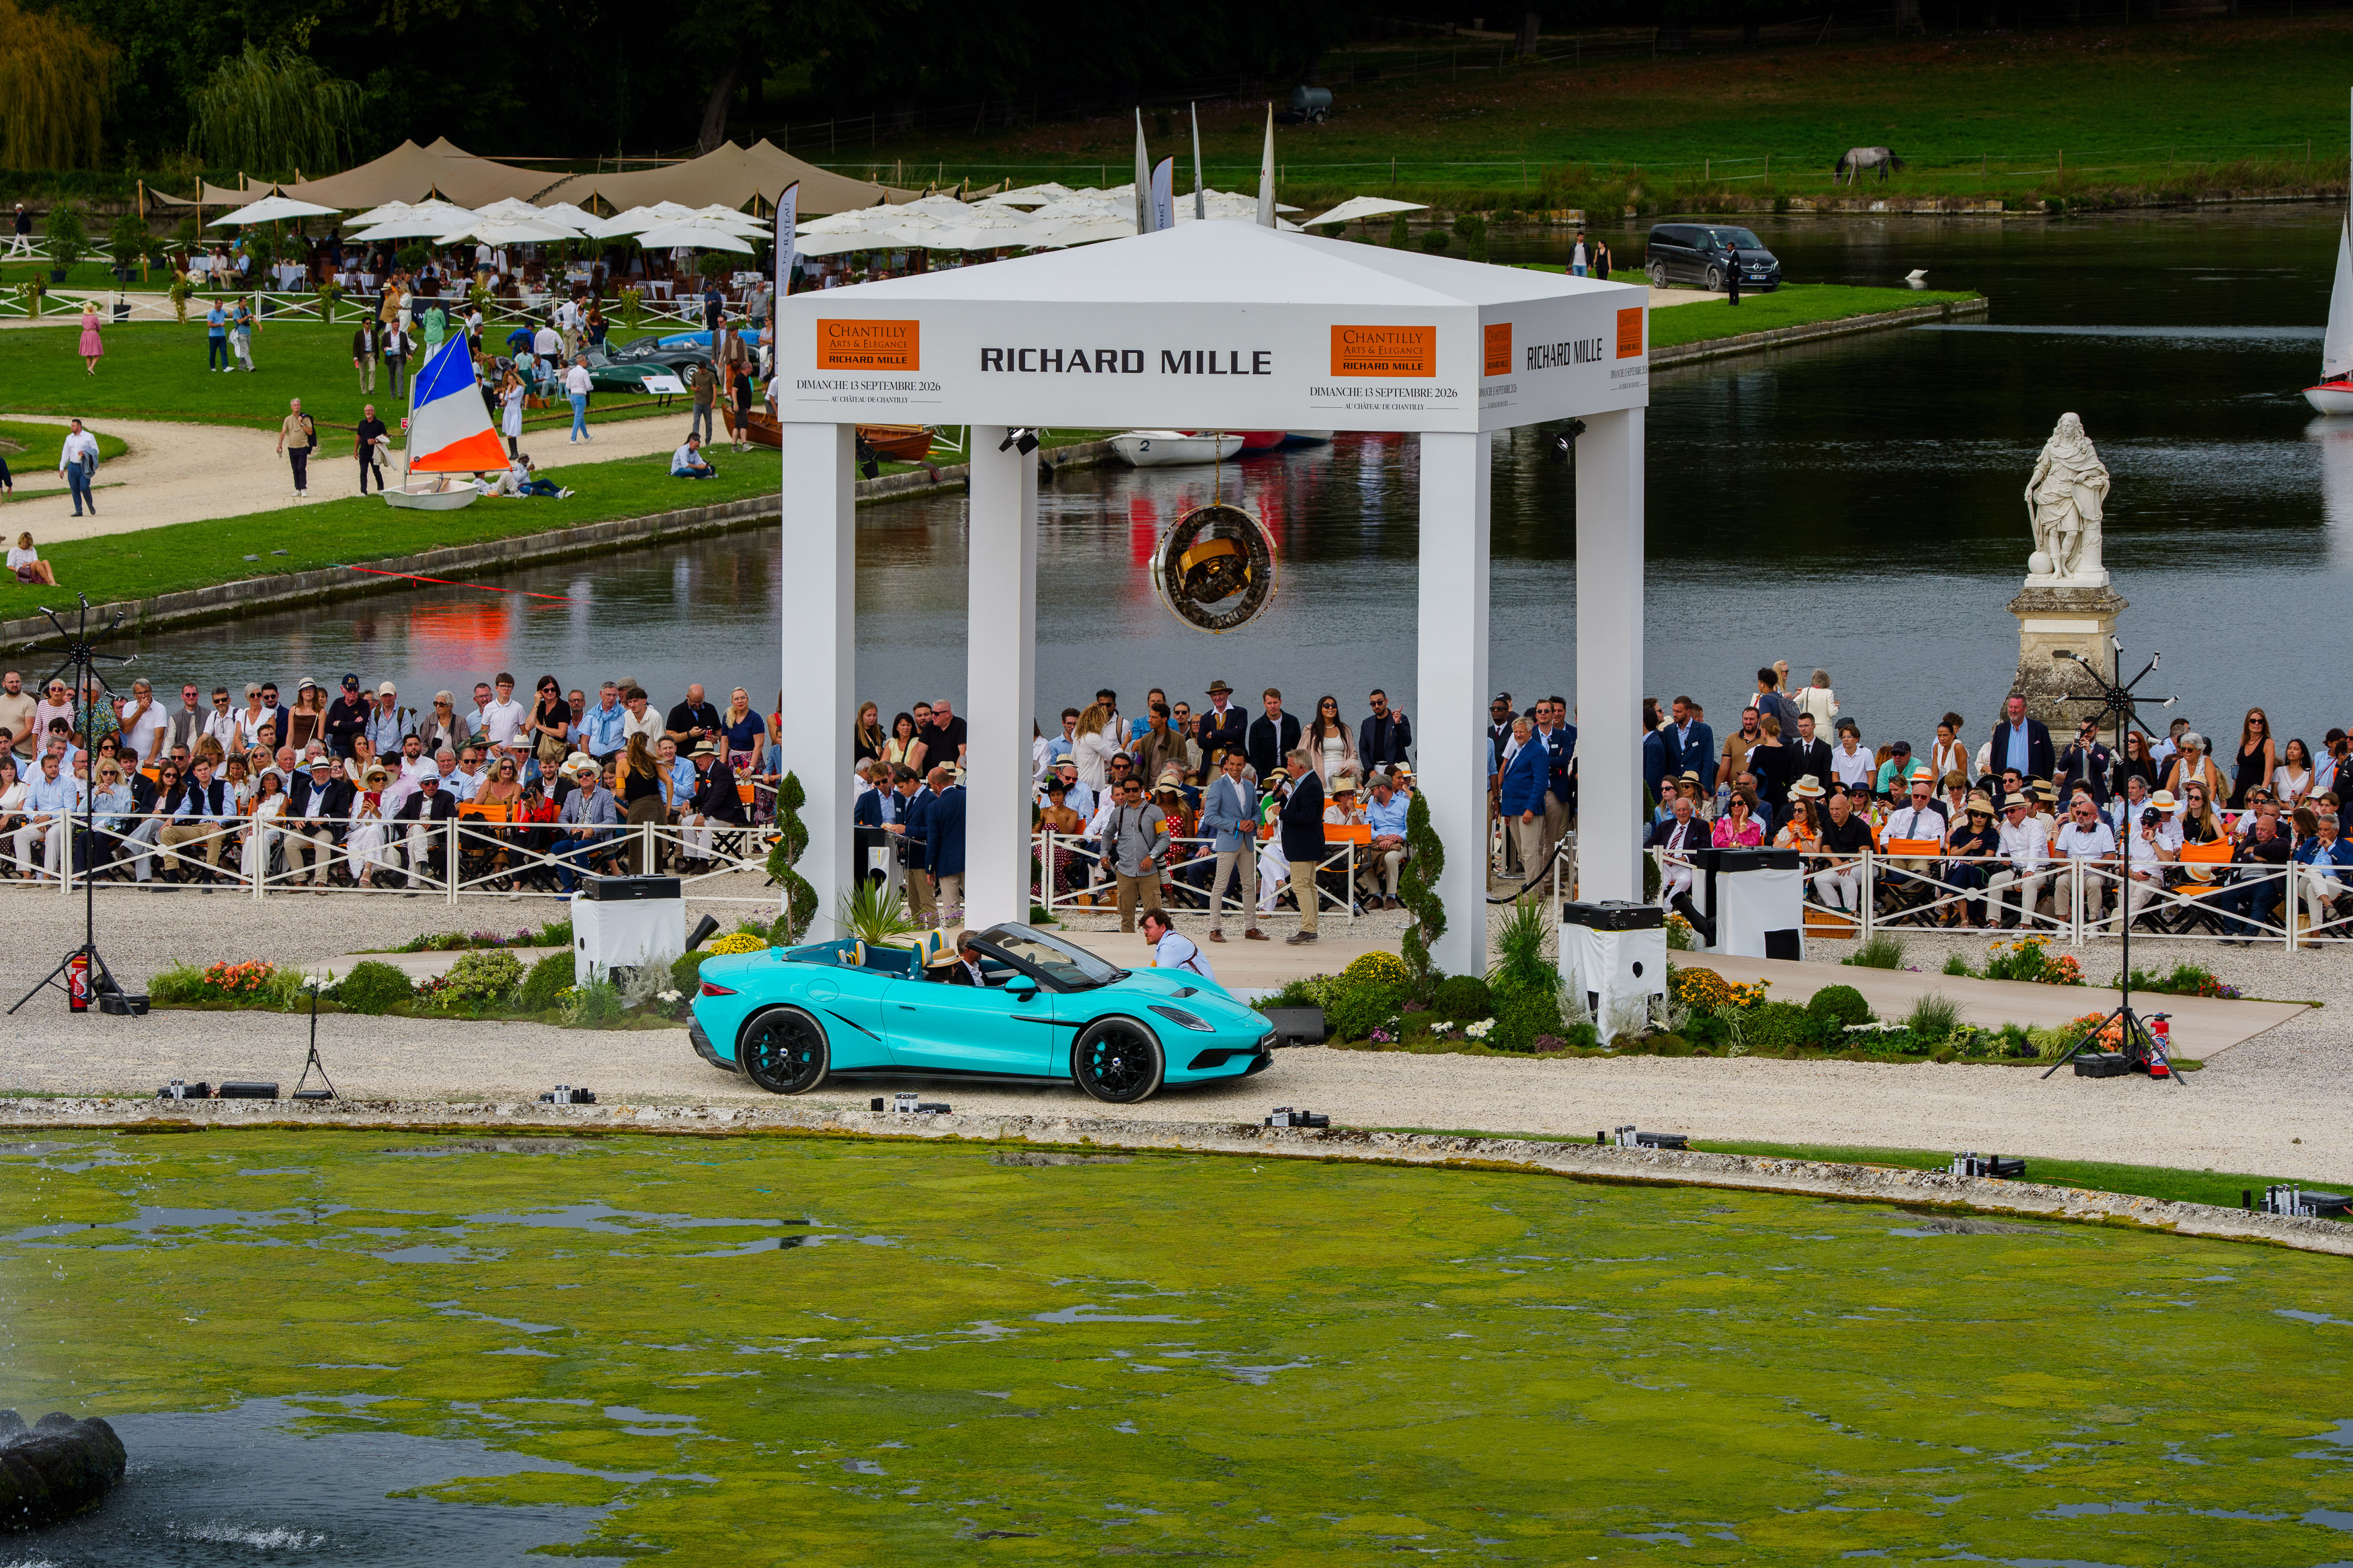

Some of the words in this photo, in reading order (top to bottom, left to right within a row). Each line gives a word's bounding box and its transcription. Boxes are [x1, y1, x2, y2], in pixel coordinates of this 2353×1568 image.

[1620, 314, 1640, 327] CHANTILLY
[829, 324, 908, 337] CHANTILLY
[1343, 330, 1423, 344] CHANTILLY
[1487, 329, 1509, 344] CHANTILLY
[830, 339, 851, 348] ARTS
[863, 339, 908, 348] ELEGANCE
[1344, 345, 1365, 354] ARTS
[1368, 346, 1375, 354] &
[1379, 345, 1424, 355] ELEGANCE
[1527, 341, 1570, 371] RICHARD
[1573, 337, 1603, 364] MILLE
[829, 356, 874, 364] RICHARD
[877, 356, 908, 364] MILLE
[980, 347, 1144, 374] RICHARD
[1161, 349, 1272, 375] MILLE
[1487, 361, 1500, 370] RICHARD
[1500, 360, 1509, 368] MILLE
[1343, 362, 1389, 370] RICHARD
[1392, 362, 1424, 371] MILLE
[797, 380, 848, 390] DIMANCHE
[850, 381, 859, 390] 13
[861, 380, 917, 391] SEPTEMBRE
[918, 382, 941, 391] 2026
[1310, 386, 1363, 397] DIMANCHE
[1365, 387, 1373, 397] 13
[1375, 387, 1433, 398] SEPTEMBRE
[1435, 388, 1458, 398] 2026
[840, 395, 867, 403] CHÂTEAU
[1353, 401, 1382, 411] CHÂTEAU
[1140, 440, 1150, 452] 2
